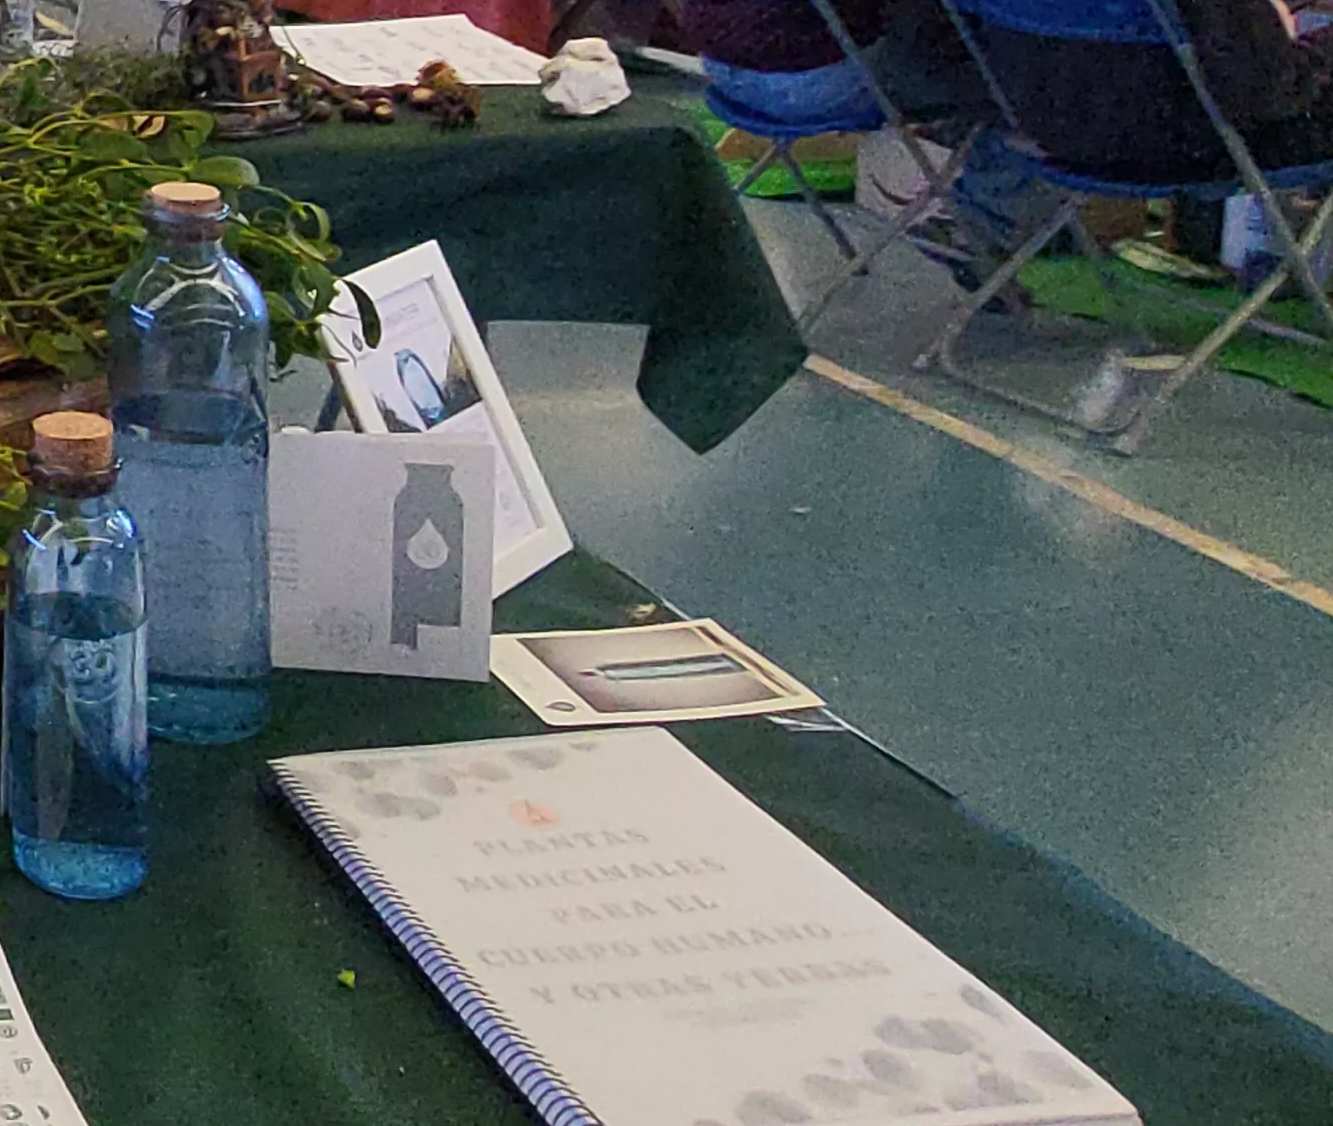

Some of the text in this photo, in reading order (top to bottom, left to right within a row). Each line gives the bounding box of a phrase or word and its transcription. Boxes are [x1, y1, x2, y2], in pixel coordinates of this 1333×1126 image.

[472, 826, 651, 859] PLANTAS
[454, 854, 728, 894] MEDICINALES
[549, 891, 720, 925] PARA EL
[477, 939, 642, 969] CUERPO
[528, 984, 556, 1005] Y
[571, 975, 716, 1002] OTRAS
